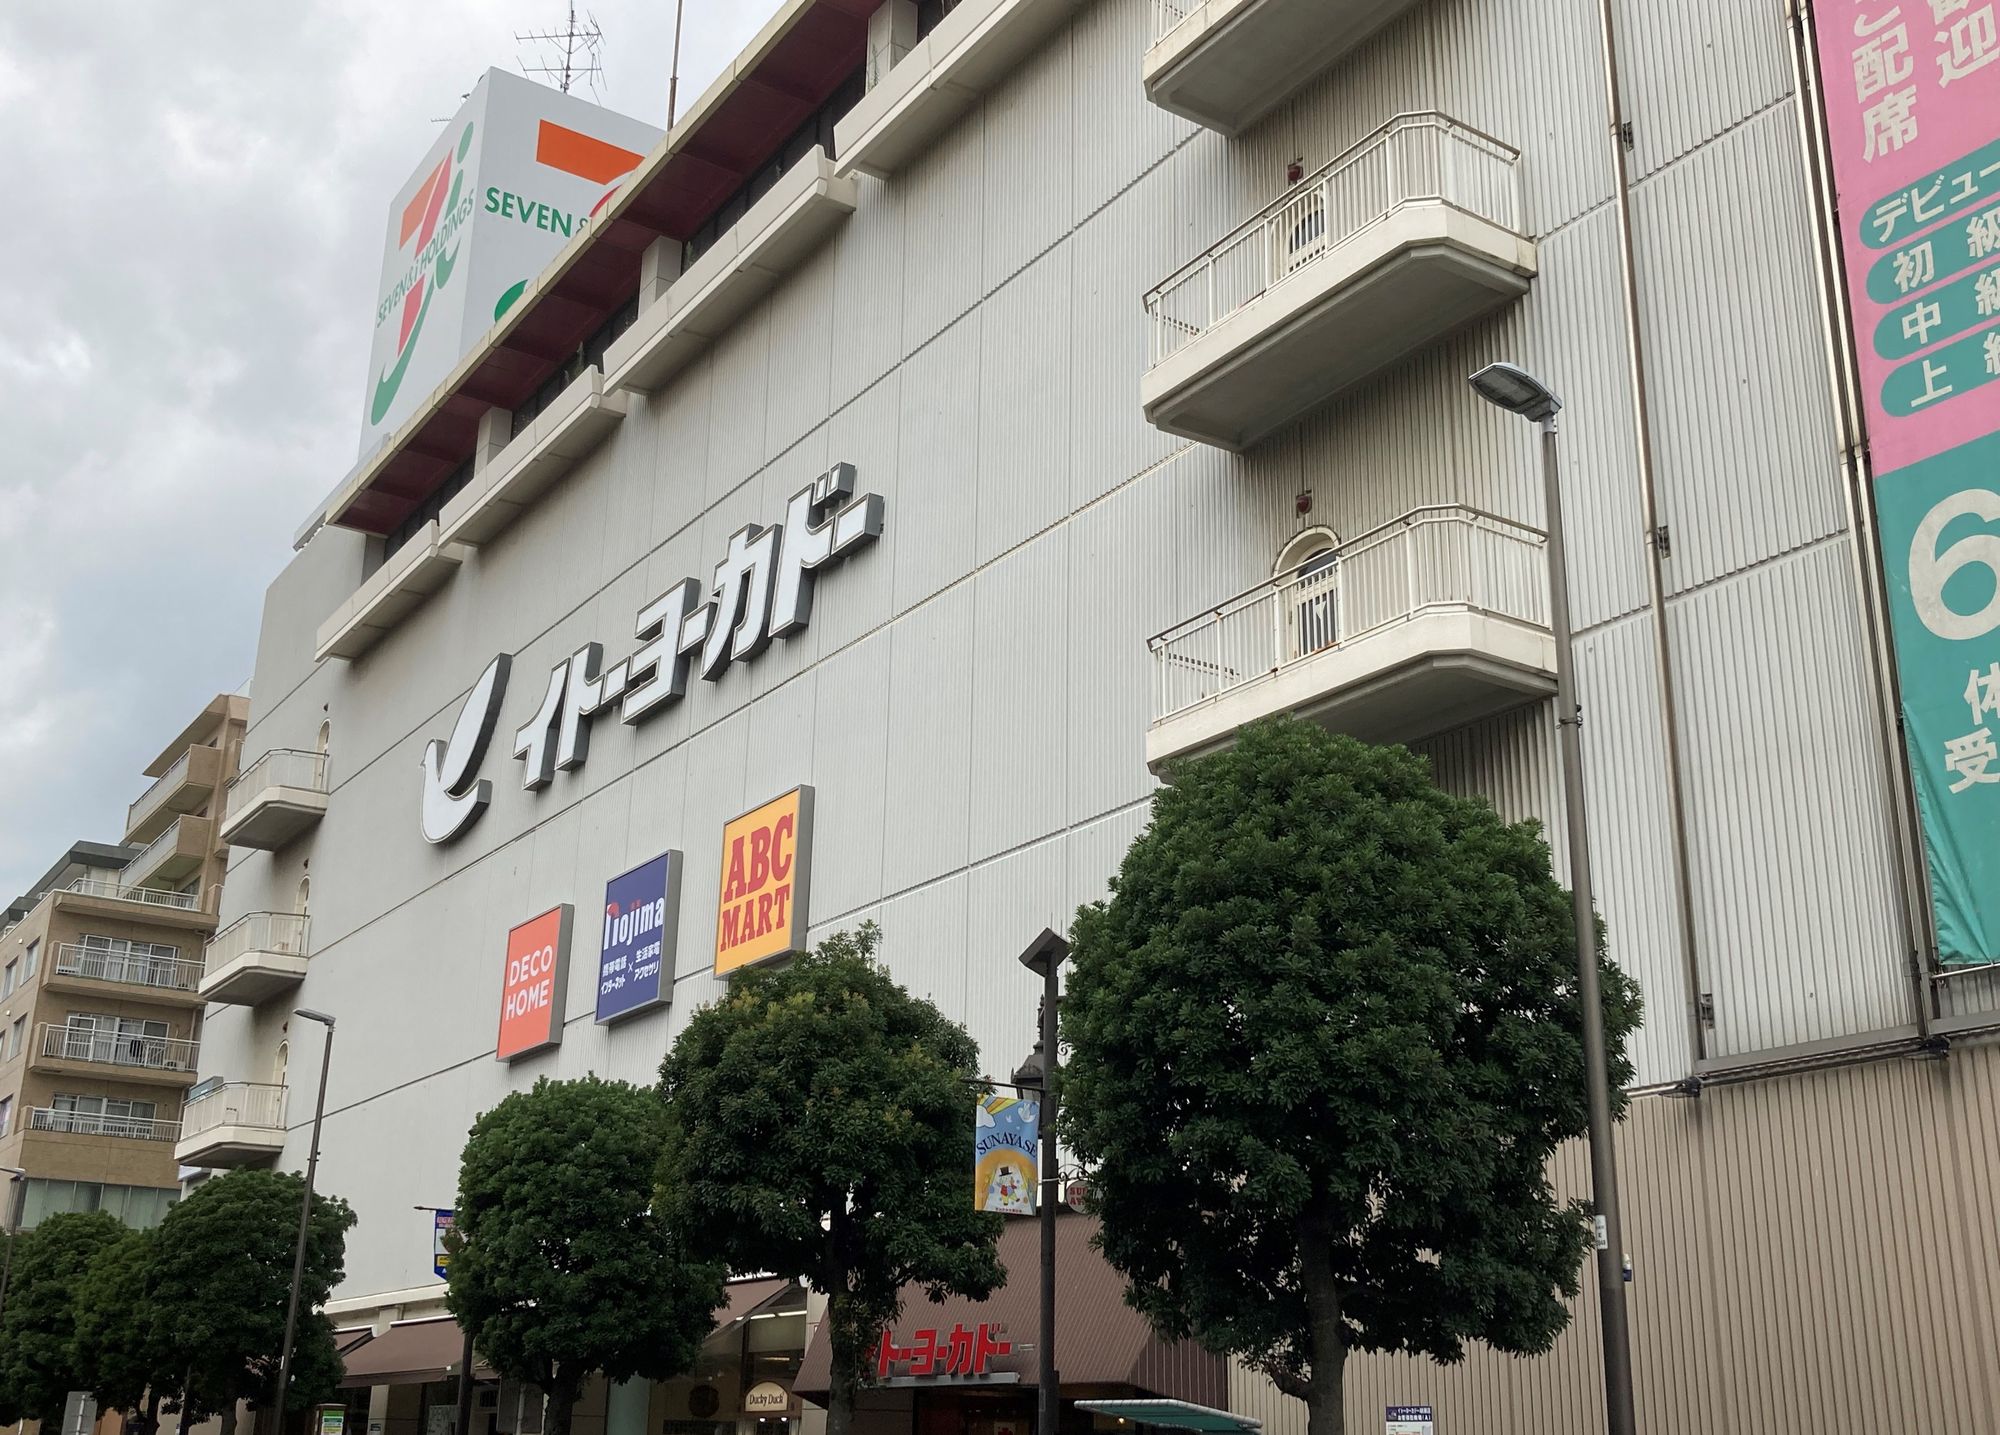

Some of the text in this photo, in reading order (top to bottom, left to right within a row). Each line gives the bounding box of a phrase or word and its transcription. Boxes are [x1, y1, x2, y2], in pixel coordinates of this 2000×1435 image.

[420, 188, 475, 274] HOLDINGS
[485, 186, 572, 238] SEVEN
[512, 462, 884, 791] イトーヨーカドー
[724, 812, 794, 904] ABC
[720, 883, 790, 953] MART
[509, 945, 553, 987] DECO
[506, 978, 550, 1021] HOME
[976, 1131, 1037, 1158] SUNAYASE
[864, 1322, 1011, 1377] トーヨーカドー
[749, 1393, 783, 1407] Ducky Duck
